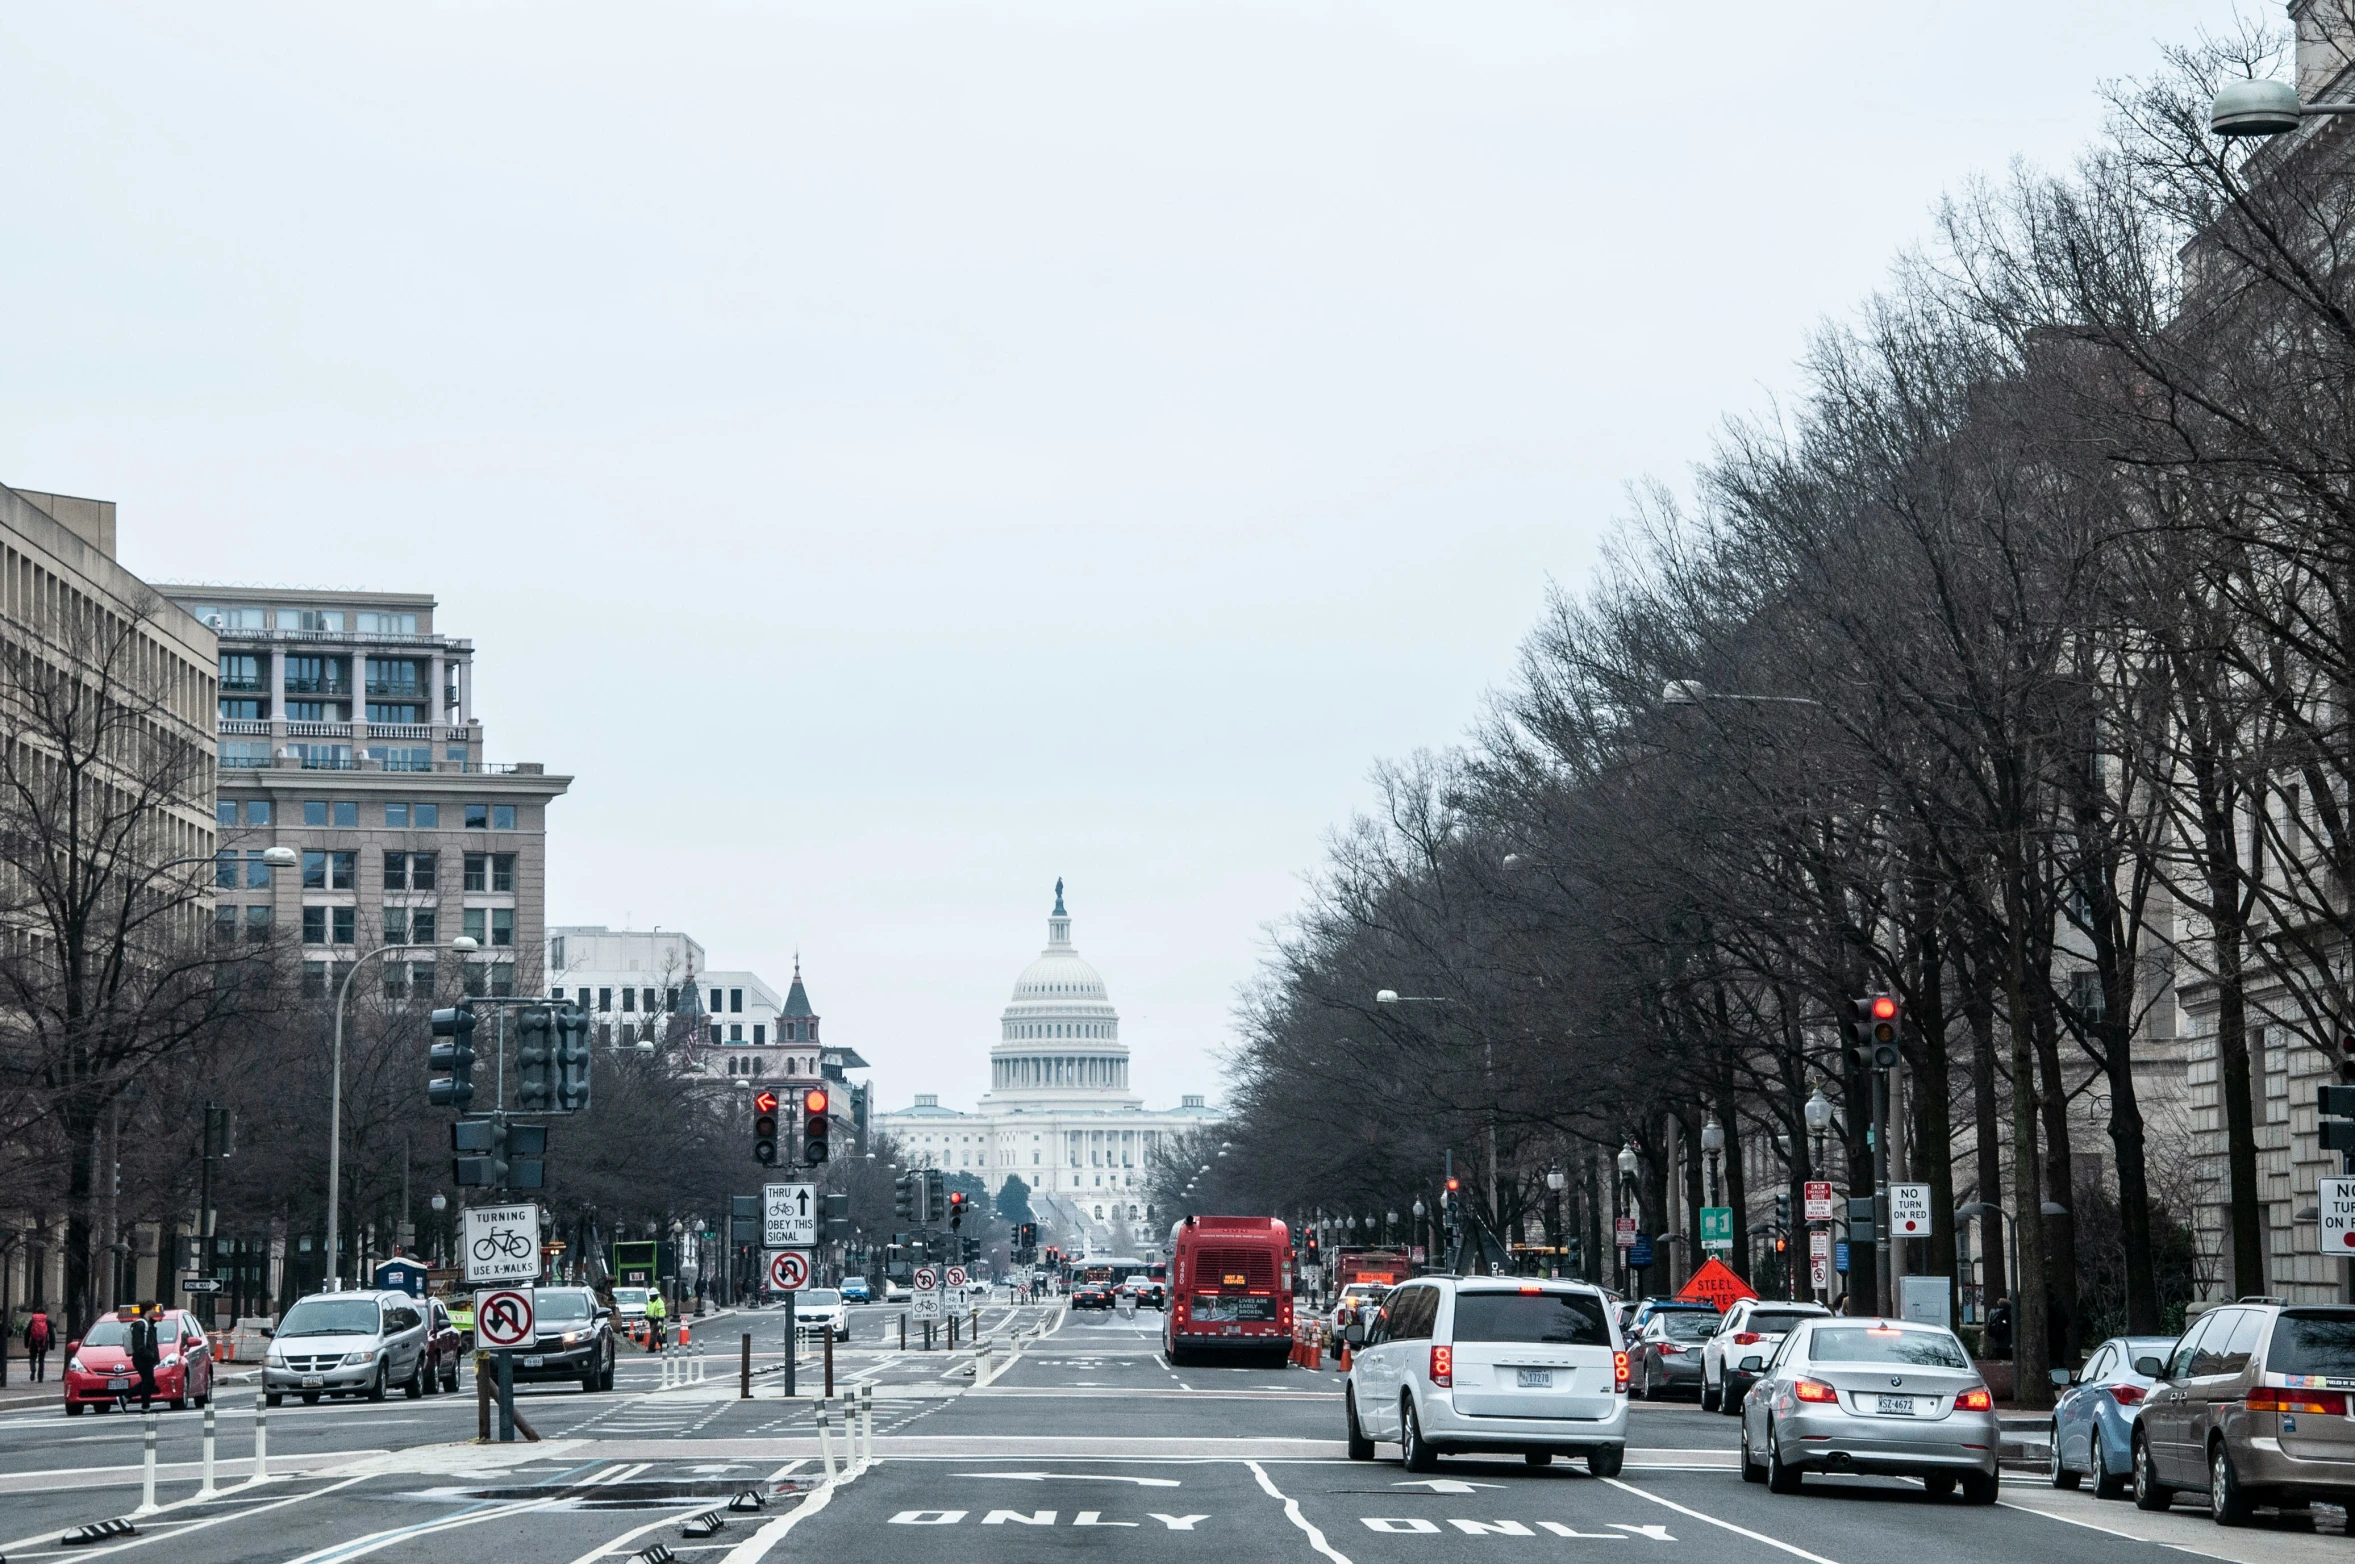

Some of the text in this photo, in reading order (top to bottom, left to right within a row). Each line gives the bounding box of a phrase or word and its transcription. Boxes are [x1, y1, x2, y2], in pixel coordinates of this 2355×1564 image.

[768, 1187, 791, 1198] THRU
[1901, 1188, 1918, 1199] NO
[2337, 1183, 2355, 1198] N
[1898, 1200, 1922, 1209] TURN
[476, 1211, 526, 1223] TURNING
[1893, 1210, 1927, 1219] ON RED
[767, 1219, 814, 1230] OBEY THIS
[2325, 1216, 2344, 1229] ON
[767, 1231, 799, 1242] SIGNAL
[473, 1262, 533, 1276] USE X-WALKS
[1698, 1279, 1733, 1291] STEEL
[887, 1509, 1212, 1531] ONLY
[1358, 1517, 1680, 1542] ONLY
